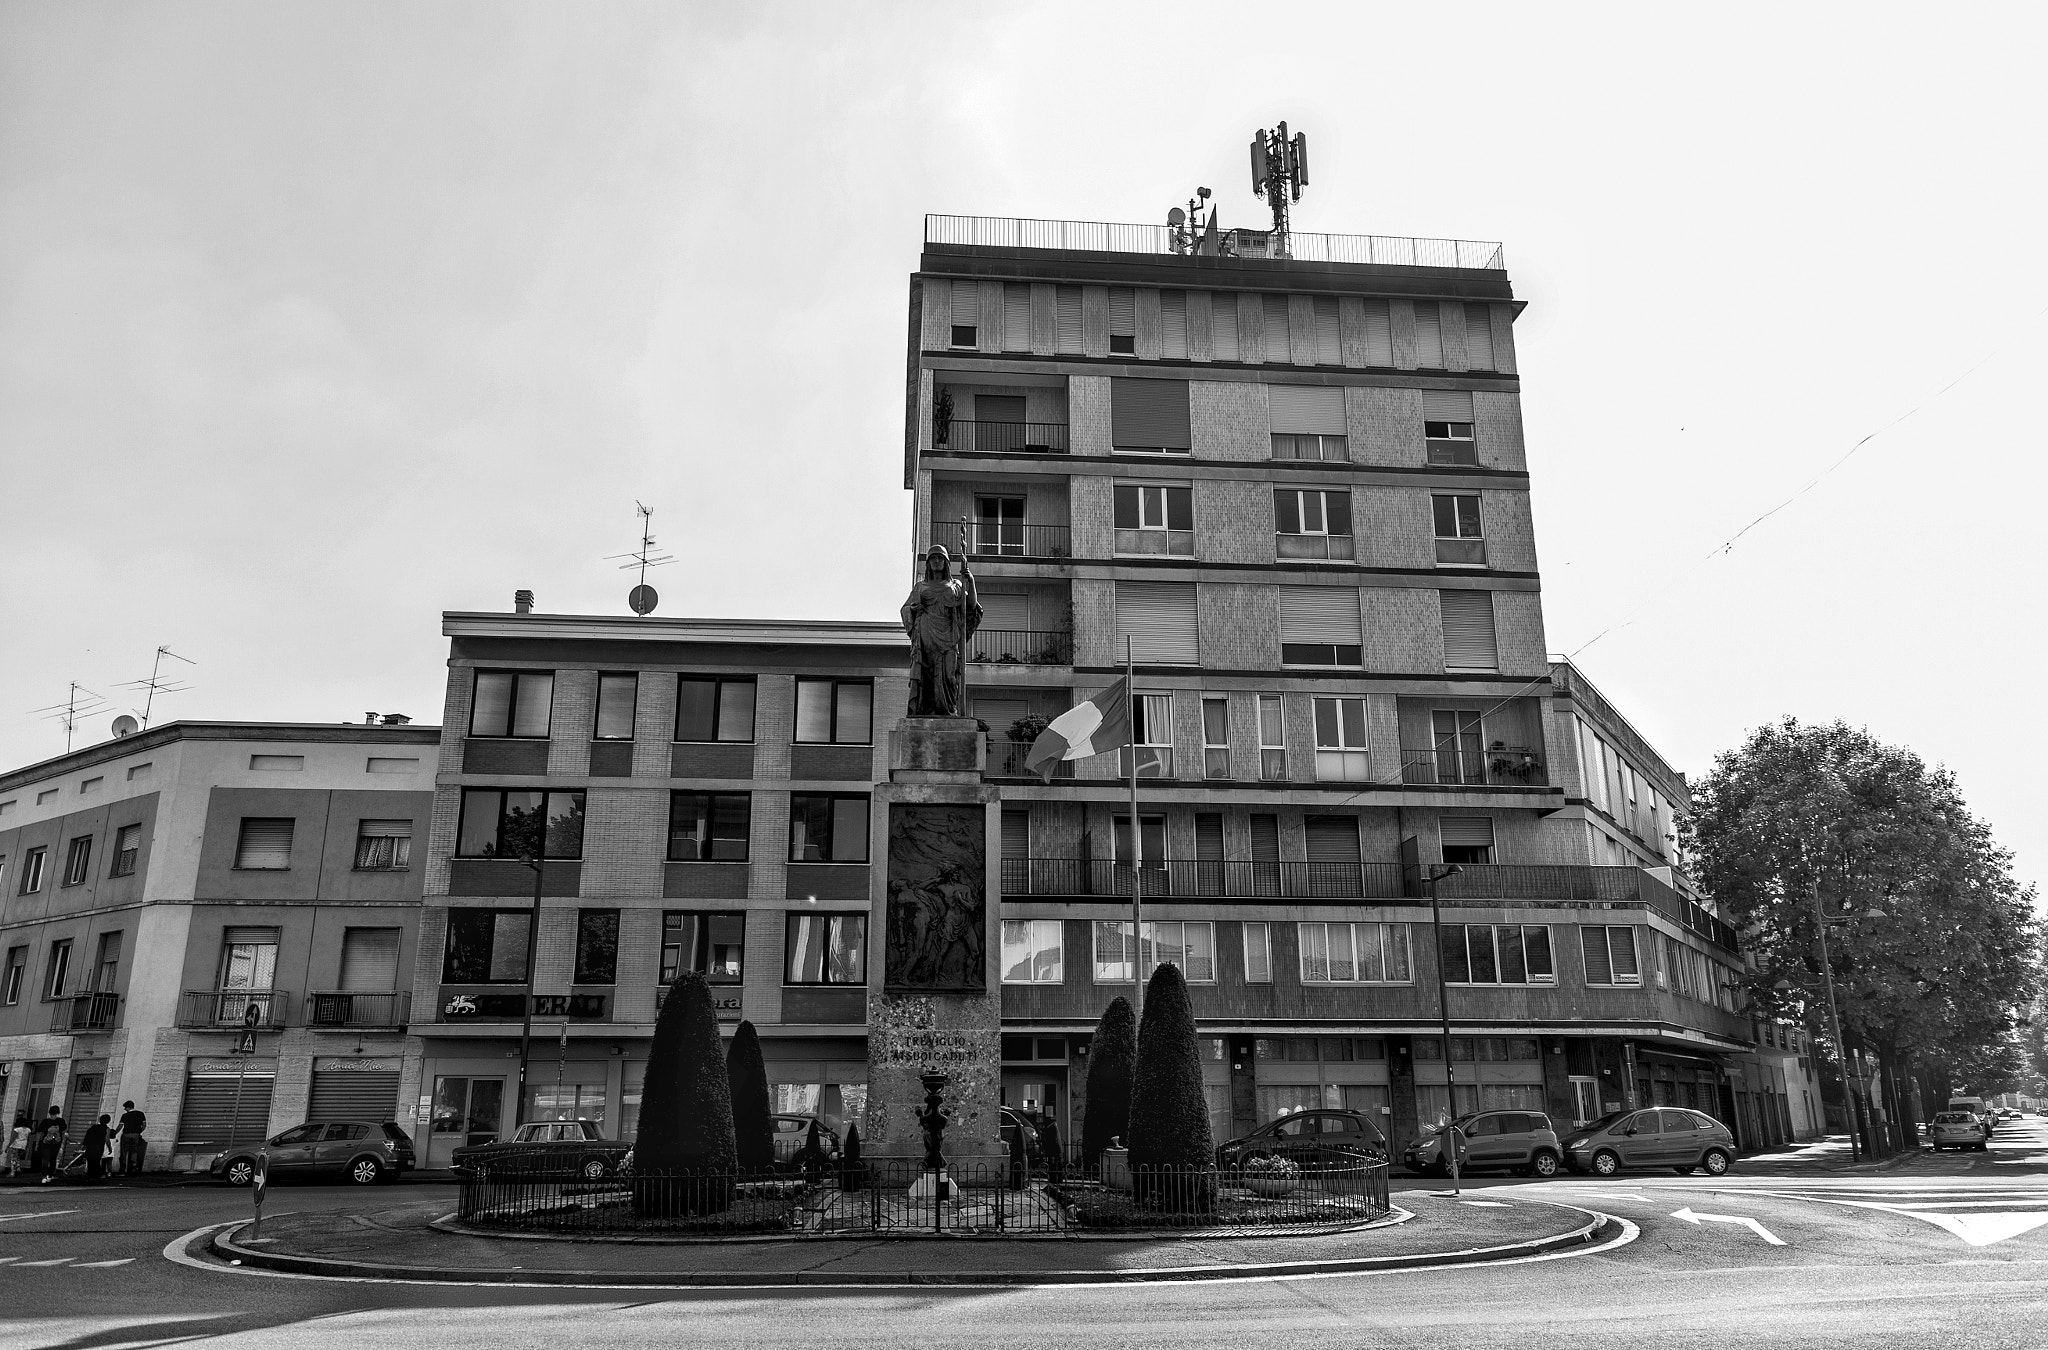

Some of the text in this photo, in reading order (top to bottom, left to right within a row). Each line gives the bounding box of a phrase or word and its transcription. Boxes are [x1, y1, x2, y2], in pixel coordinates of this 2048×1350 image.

[905, 1036, 966, 1047] TREVIGLIO
[892, 1051, 977, 1061] AI SUOI CADUTI
[197, 1059, 231, 1071] Amici
[322, 1058, 357, 1071] Amici
